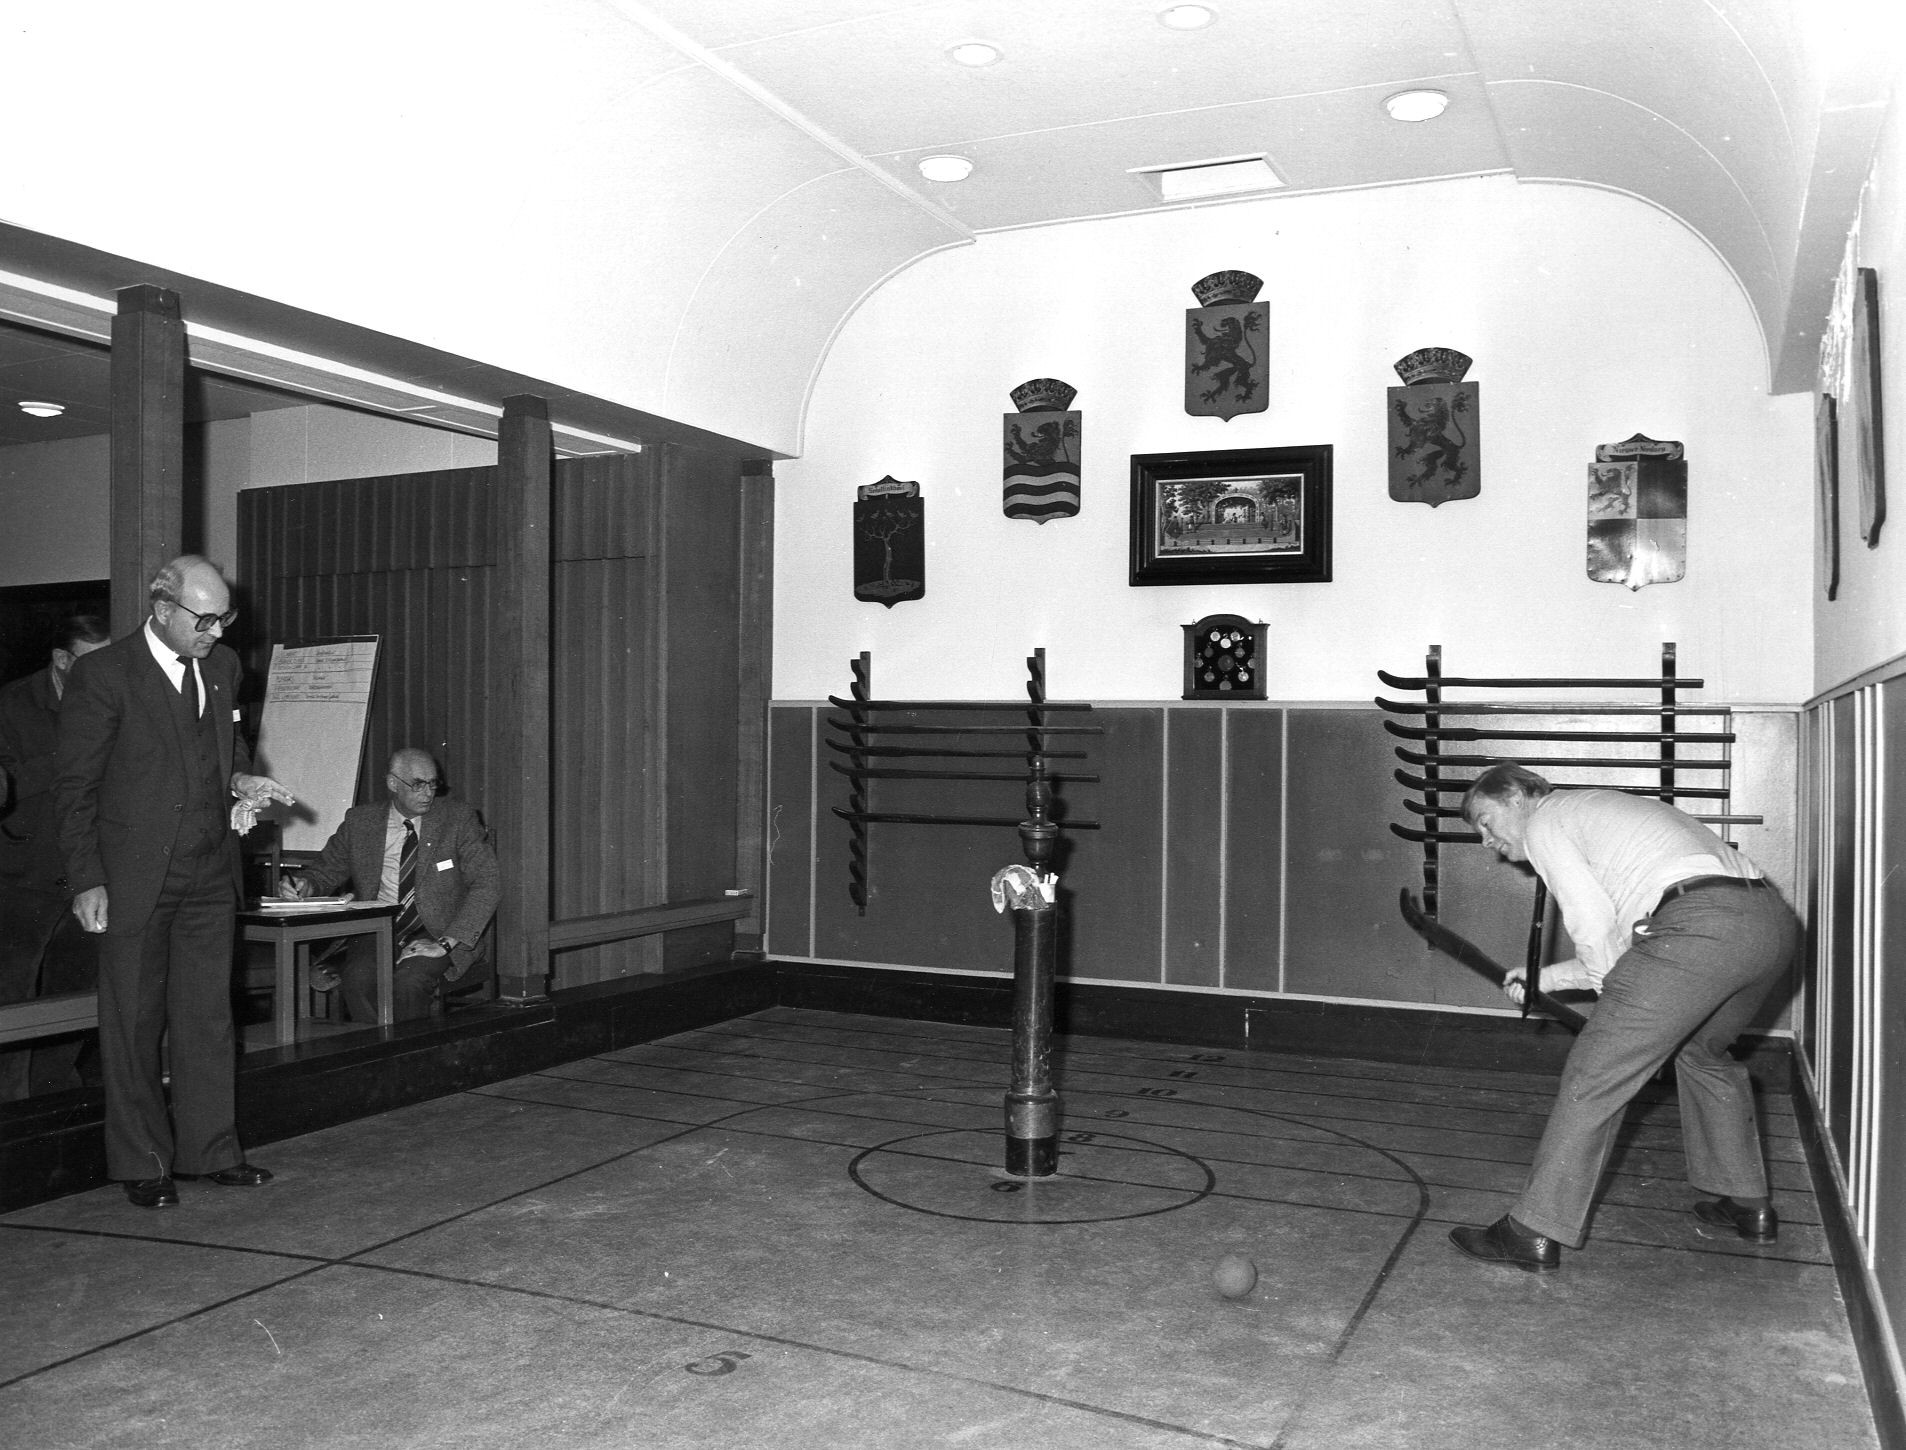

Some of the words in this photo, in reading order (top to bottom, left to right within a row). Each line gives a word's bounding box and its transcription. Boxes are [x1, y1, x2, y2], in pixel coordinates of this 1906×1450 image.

[1189, 1054, 1227, 1063] 12
[1168, 1070, 1199, 1079] 11
[1138, 1087, 1178, 1097] 10
[1103, 1109, 1130, 1118] 9
[1067, 1132, 1097, 1143] 8
[990, 1180, 1026, 1193] 6
